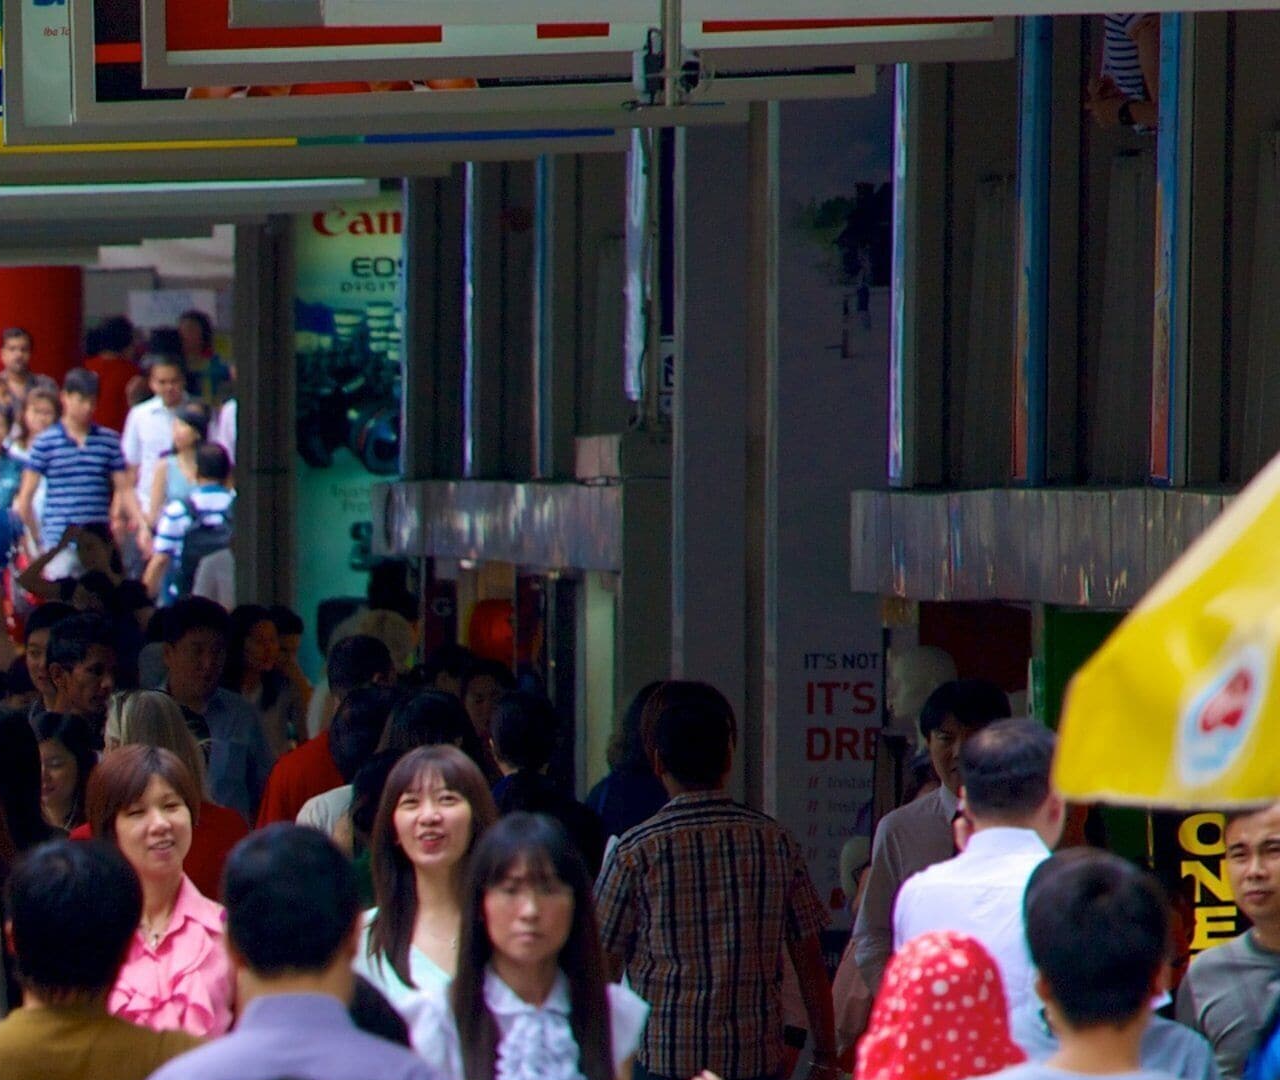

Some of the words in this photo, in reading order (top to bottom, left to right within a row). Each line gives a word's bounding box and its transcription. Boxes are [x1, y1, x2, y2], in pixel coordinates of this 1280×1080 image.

[804, 652, 838, 670] IT'S
[842, 652, 878, 670] NOT
[806, 681, 877, 716] IT'S
